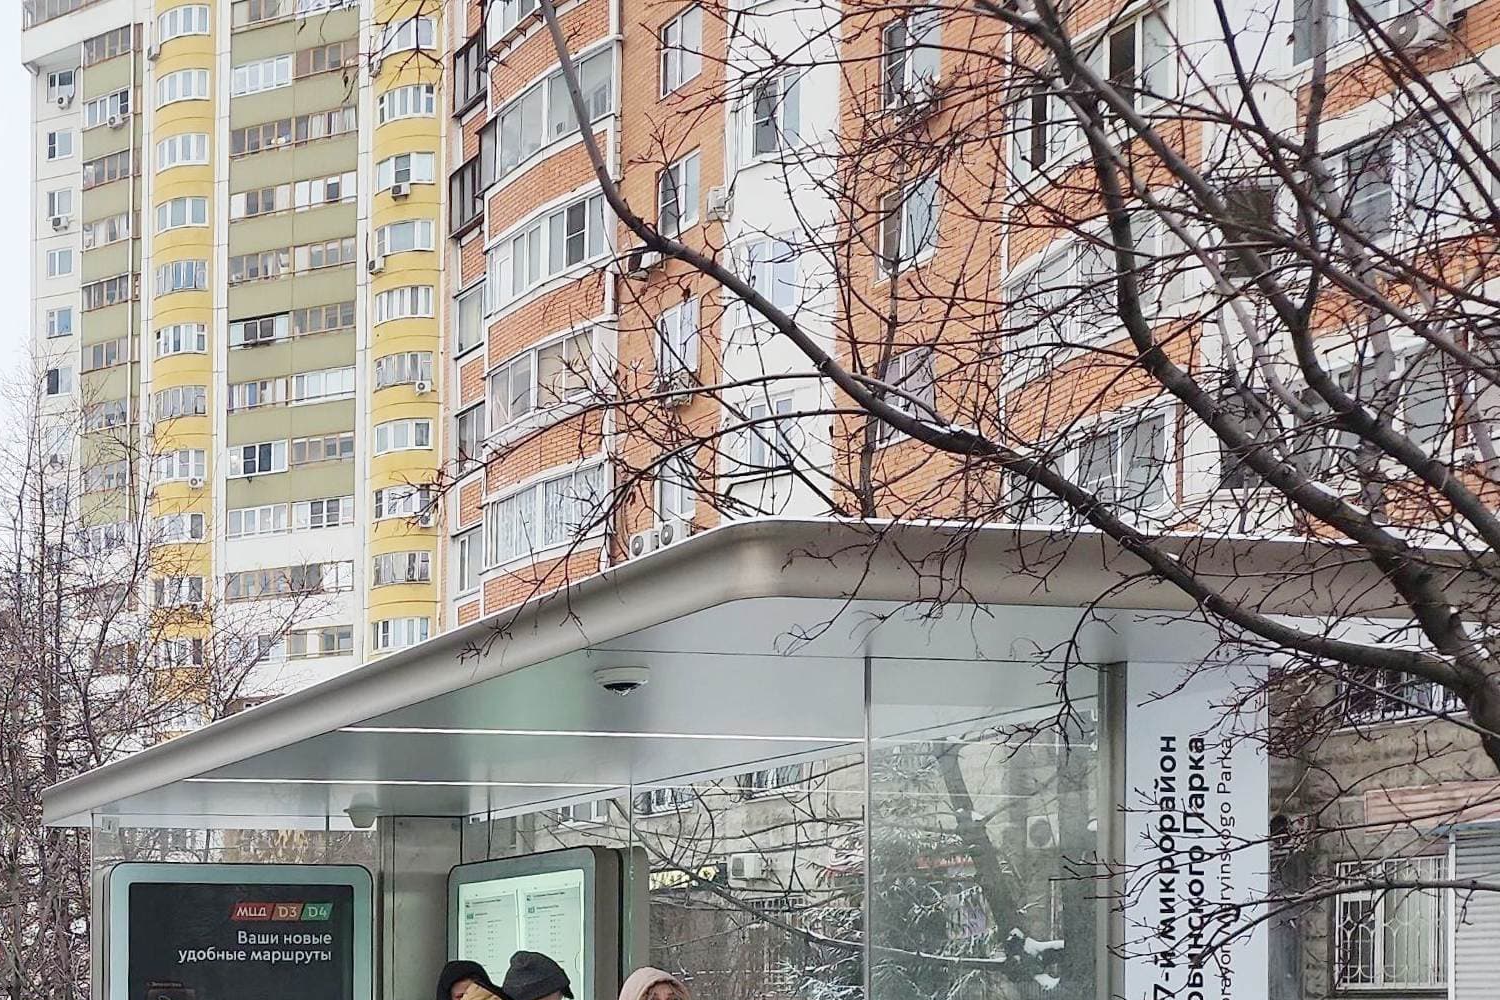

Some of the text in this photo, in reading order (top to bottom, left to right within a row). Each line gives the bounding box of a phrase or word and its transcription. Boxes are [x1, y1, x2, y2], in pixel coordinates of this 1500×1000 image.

[1216, 738, 1232, 794] Parka
[1183, 737, 1209, 834] Парка
[1153, 736, 1180, 1000] 7-й микрорайон
[236, 906, 327, 918] МЦД D3 D4
[178, 946, 332, 964] удобные маршруты
[237, 930, 332, 944] Ваши новые
